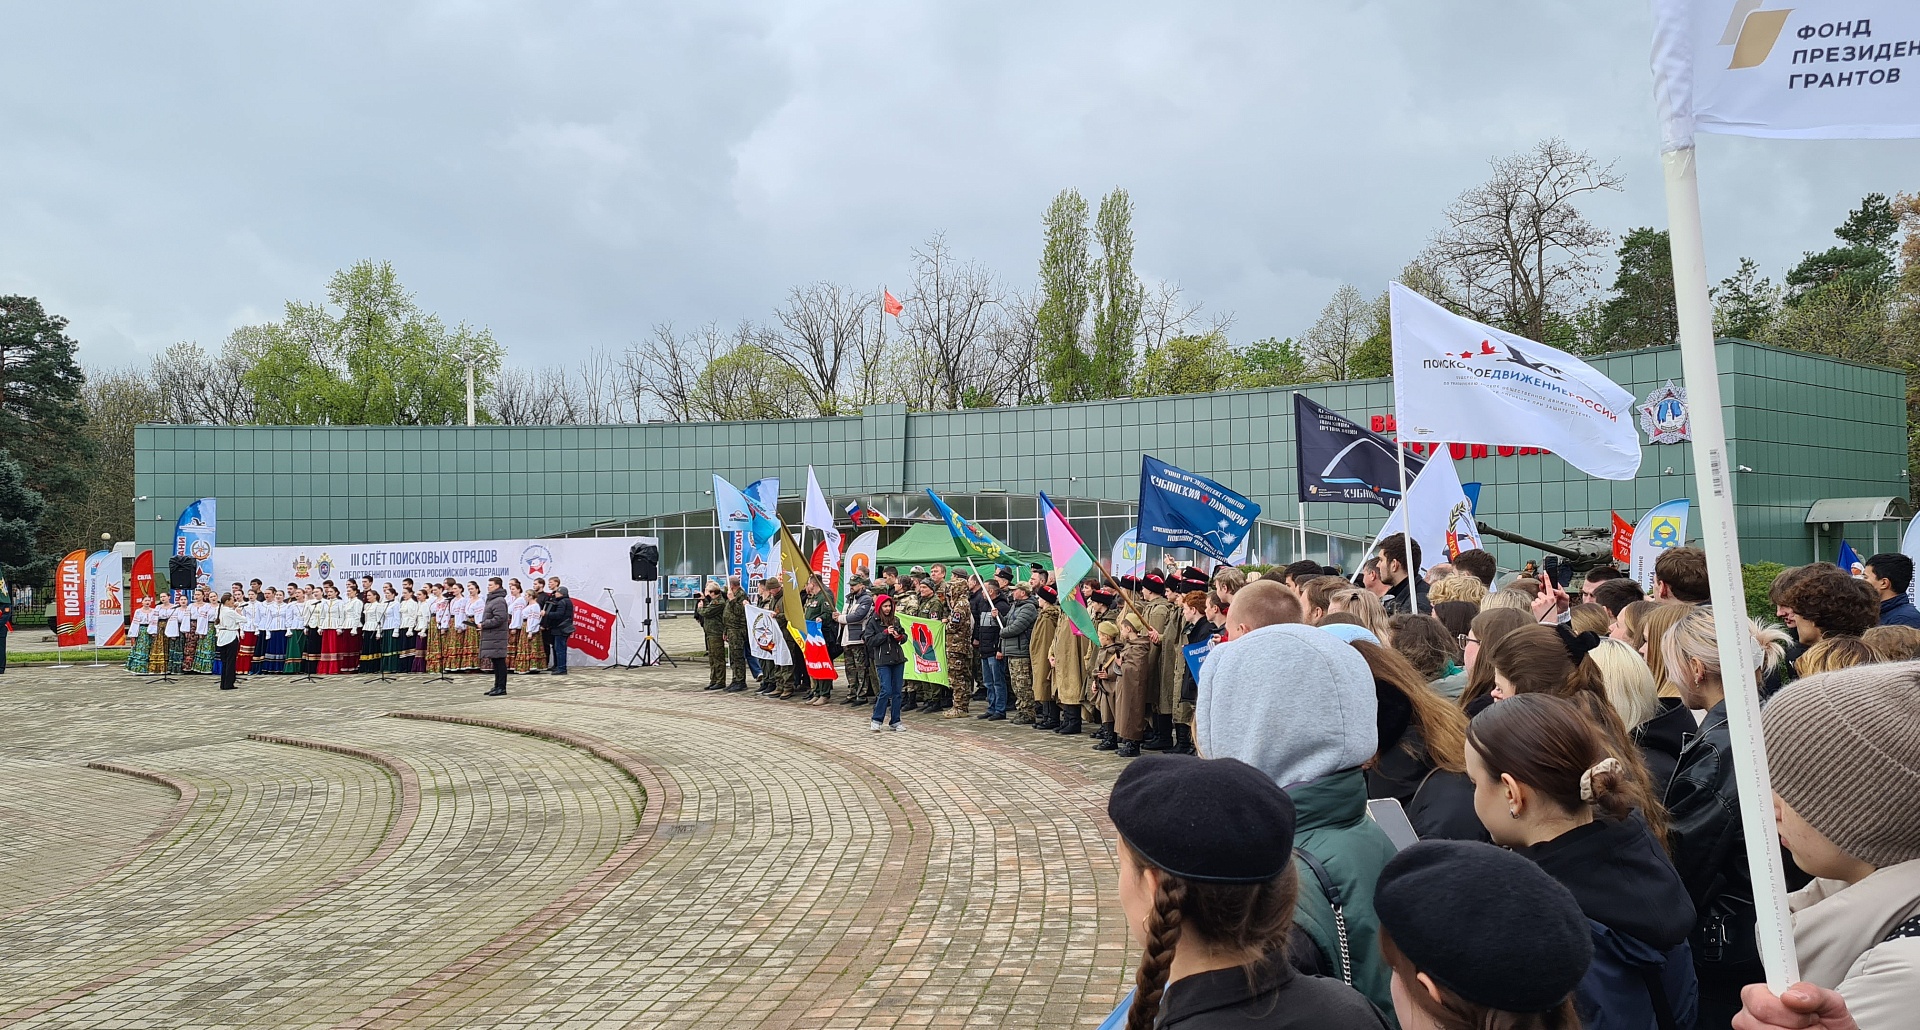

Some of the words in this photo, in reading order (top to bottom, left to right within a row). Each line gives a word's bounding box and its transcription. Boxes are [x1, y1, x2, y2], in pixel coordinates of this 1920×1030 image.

[1797, 19, 1871, 40] ФОНД
[1792, 40, 1920, 64] ПРЕЗИДЕН
[1788, 67, 1901, 90] ГРАНТОВ
[362, 550, 387, 566] СЛЁТ
[390, 551, 449, 565] ПОИСКОВЫХ
[452, 549, 498, 564] ОТРЯДОВ
[339, 569, 391, 580] СЛЕДСТВЕННОГО
[393, 569, 426, 579] КОМИТЕТА
[427, 566, 468, 578] РОССИЙСКОЙ
[469, 566, 510, 577] ФЕДЕРАЦИИ
[63, 560, 80, 616] ПОБЕДА!
